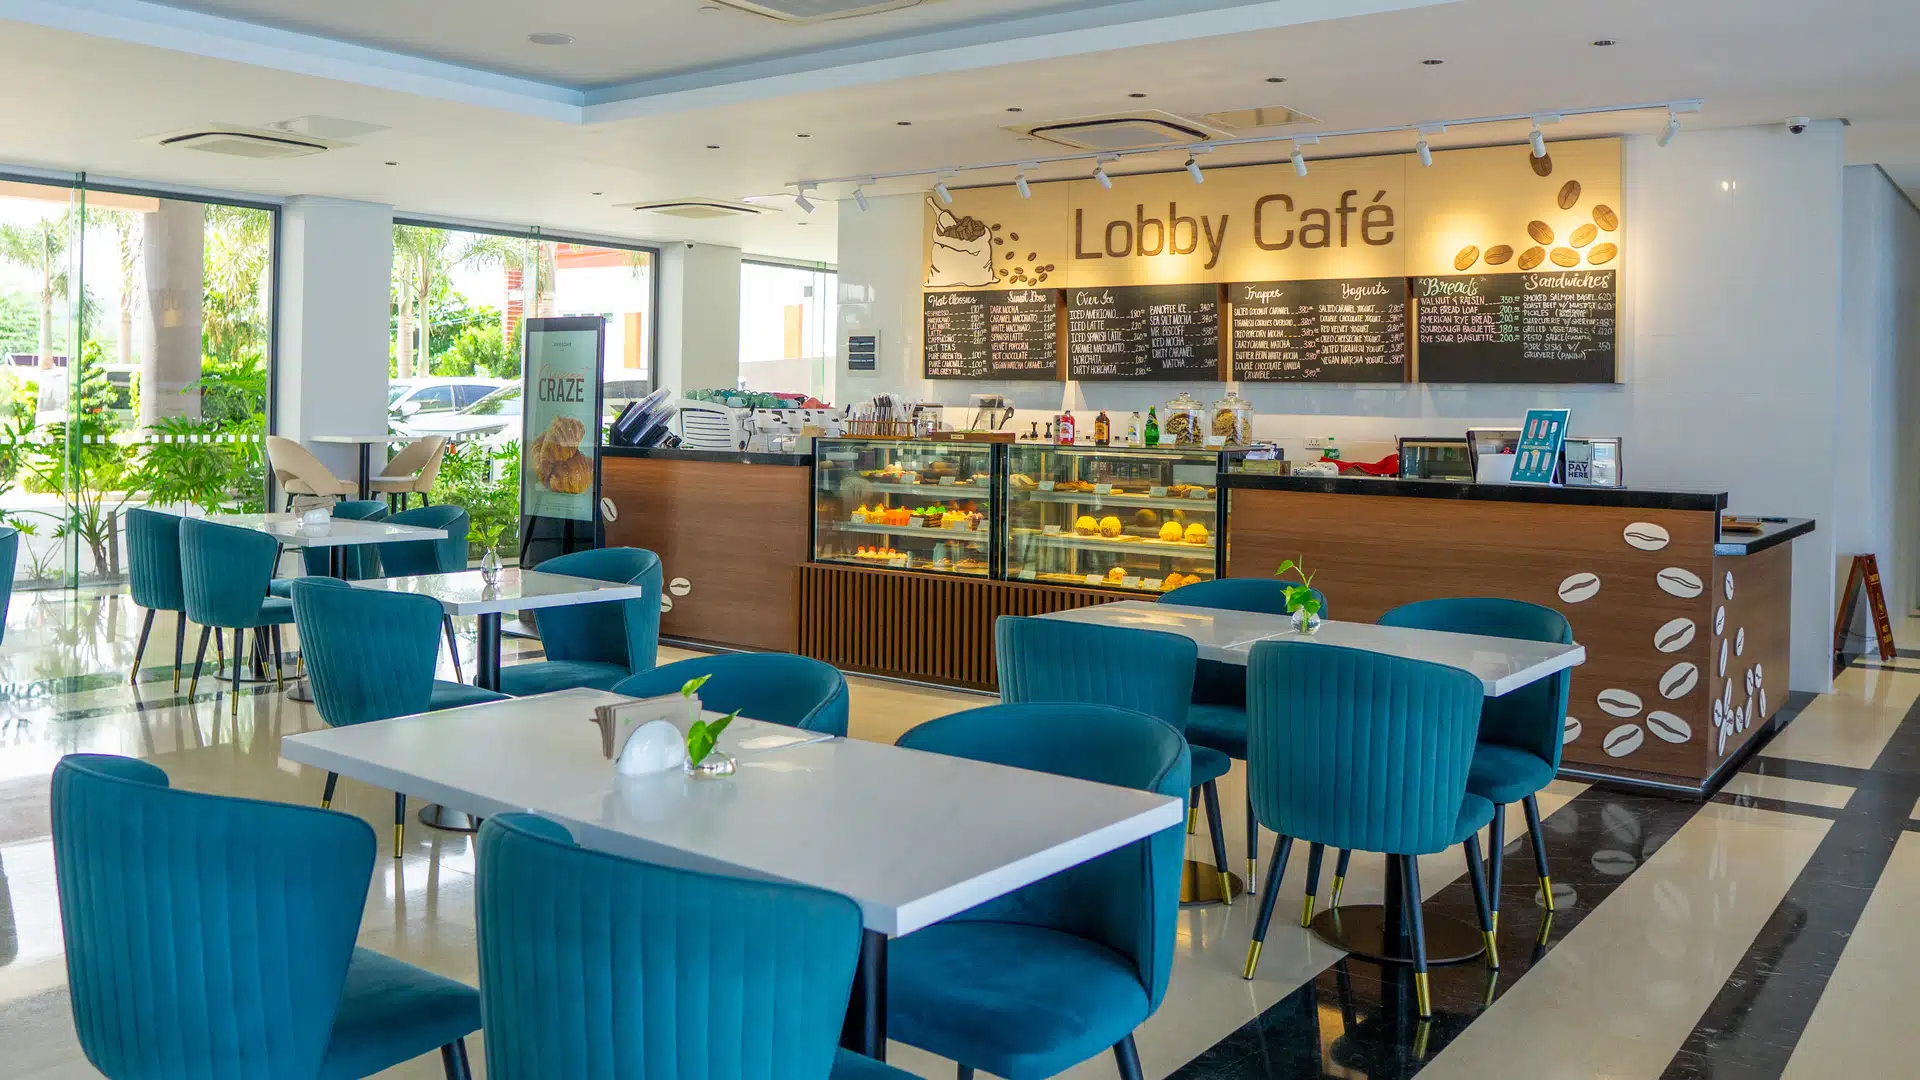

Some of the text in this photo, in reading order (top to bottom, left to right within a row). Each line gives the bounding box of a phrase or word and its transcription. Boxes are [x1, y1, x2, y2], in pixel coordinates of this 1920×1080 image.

[1075, 190, 1395, 270] Lobby Café
[1525, 272, 1610, 290] Sandwiches
[1342, 281, 1390, 301] Yogurts
[1423, 278, 1479, 296] Breads
[1077, 291, 1100, 306] Over
[1420, 296, 1450, 306] WALNUT
[1460, 296, 1485, 305] RAISIN
[1523, 294, 1548, 302] SMOKED
[1550, 293, 1575, 302] SALMON
[1150, 305, 1177, 315] BANOFFEE
[1420, 306, 1439, 315] SOUR
[1440, 306, 1460, 314] BREAD
[1462, 306, 1478, 314] LOAF
[990, 315, 1011, 323] CARAMEL
[1070, 310, 1085, 320] ICED
[1150, 315, 1192, 326] SEA SALT MOCHA
[1420, 316, 1452, 324] AMERICAN
[1454, 316, 1469, 324] RYE
[1471, 316, 1493, 325] BREAD
[991, 324, 1005, 333] WHITE
[1071, 320, 1105, 332] ICED LATTE
[1321, 325, 1331, 333] RED
[1421, 325, 1461, 334] SOURDOUGH
[1463, 325, 1496, 334] BAGUETTE
[1523, 326, 1547, 334] GRILLED
[1162, 326, 1185, 336] BISCOFF
[1267, 330, 1284, 338] MOCHA
[991, 333, 1024, 342] SPANISH LATTE
[1071, 332, 1086, 343] ICED
[1421, 335, 1433, 343] RYE
[1436, 335, 1454, 343] SOUR
[1457, 334, 1493, 343] BAGUETTE
[1152, 337, 1185, 348] ICED MOCHA
[1523, 342, 1541, 351] PORK
[929, 344, 939, 352] HOT
[992, 352, 1002, 360] HOT
[1152, 347, 1193, 359] DIRTY CARAMEL
[1236, 351, 1254, 360] BUTTER
[1073, 355, 1102, 365] HORCHATA
[1321, 356, 1340, 365] VEGAN
[1074, 365, 1090, 375] DIRTY
[1235, 362, 1253, 370] DOUBLE
[1254, 362, 1282, 370] CHOCOLATE
[539, 378, 585, 403] CRAZE
[1568, 464, 1588, 472] PAY
